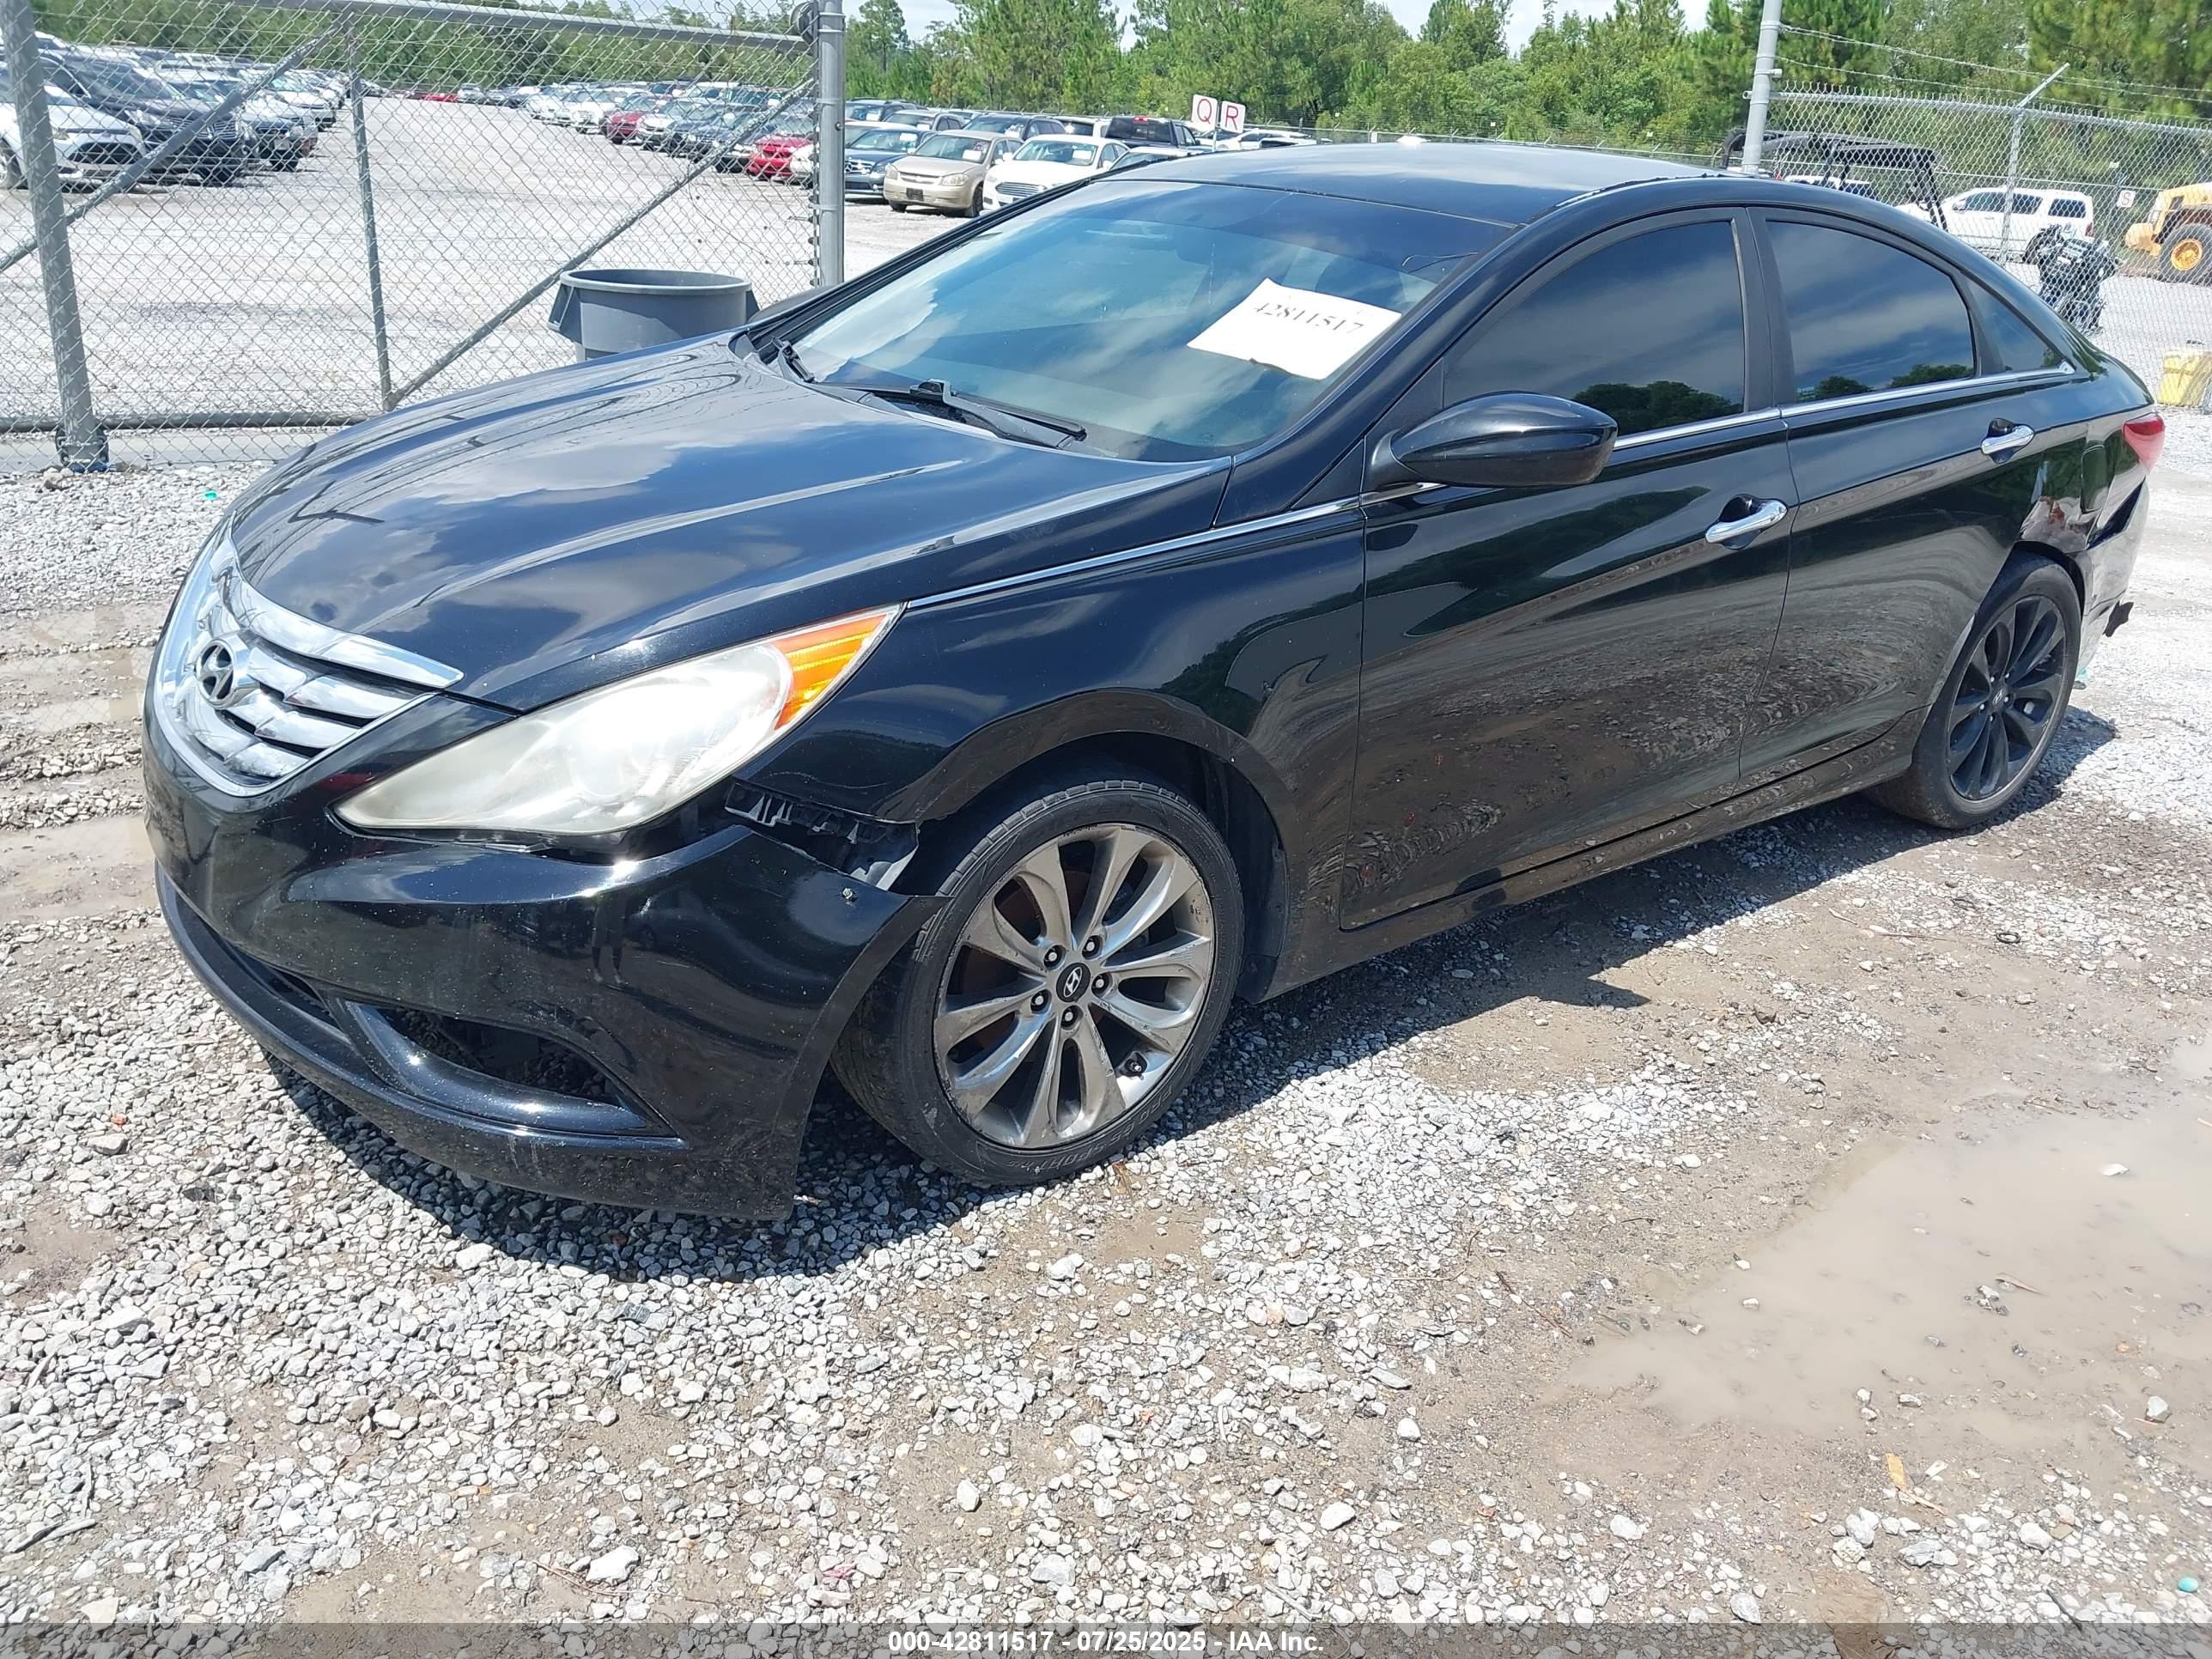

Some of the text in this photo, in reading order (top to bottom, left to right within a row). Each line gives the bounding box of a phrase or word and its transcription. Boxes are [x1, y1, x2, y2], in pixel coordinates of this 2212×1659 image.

[1197, 98, 1212, 124] Q
[1225, 105, 1238, 131] R
[2121, 191, 2130, 205] S
